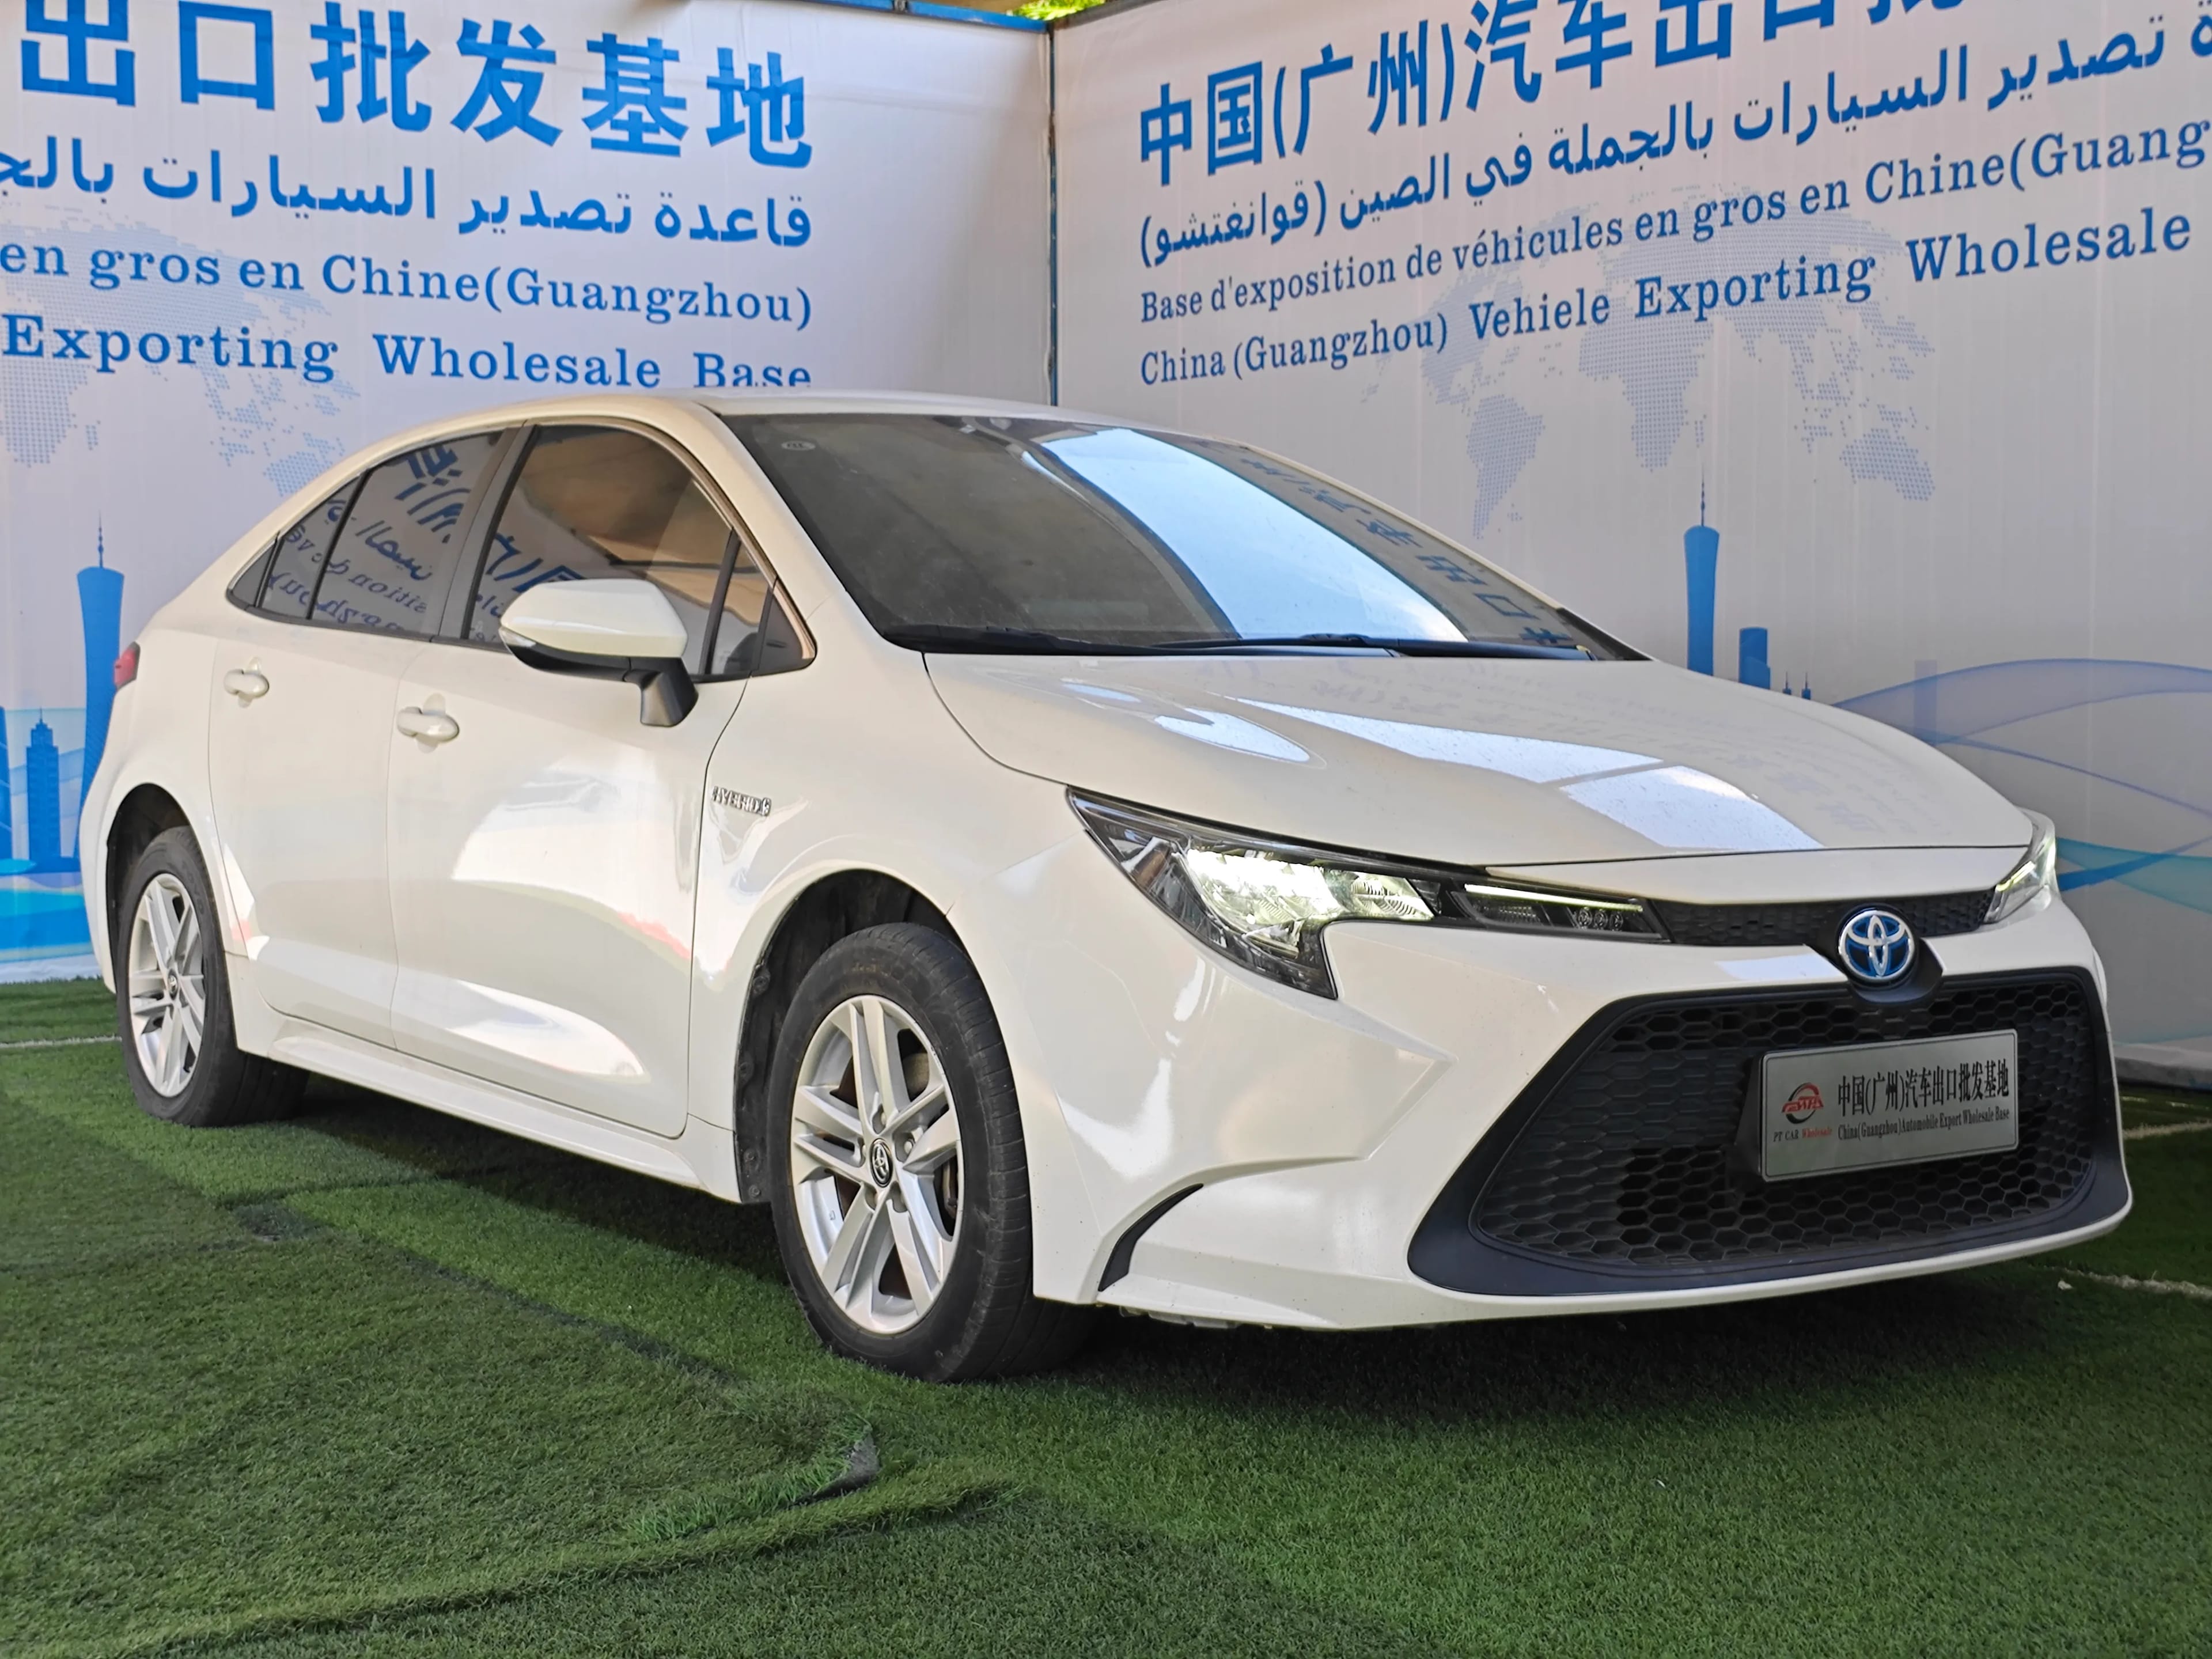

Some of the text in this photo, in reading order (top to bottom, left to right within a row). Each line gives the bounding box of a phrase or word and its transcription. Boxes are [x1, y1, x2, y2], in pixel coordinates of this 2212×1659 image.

[21, 0, 812, 168] 出口批发基地
[1733, 44, 1967, 145] السيارات
[1987, 14, 2164, 111] تصدير
[1466, 132, 1532, 207] في
[1548, 101, 1713, 175] بالجملة
[143, 149, 435, 219] السيارات
[458, 190, 631, 234] تصدير
[654, 192, 811, 247] قاعدة
[1340, 153, 1450, 229] الصين
[0, 243, 811, 331] en gros en Chine(Guangzhou)
[1141, 291, 1202, 323] Base
[1211, 255, 1396, 312] d'exposition
[1406, 245, 1442, 279] de
[1453, 216, 1623, 271] véhicules
[1634, 208, 1680, 242] en
[1693, 190, 1786, 242] gros
[1800, 178, 1850, 215] en
[1141, 207, 2190, 385] China (Guangzhou) Vehiele Exporting Wholesale
[2, 313, 811, 388] Exporting Wholesale Base
[1838, 1059, 2009, 1116] 中国(广州)汽车出口批发基地
[1940, 1112, 1961, 1131] Export
[1963, 1107, 1994, 1124] Wholesale
[1995, 1105, 2010, 1121] Base
[1785, 1129, 1798, 1141] CAR
